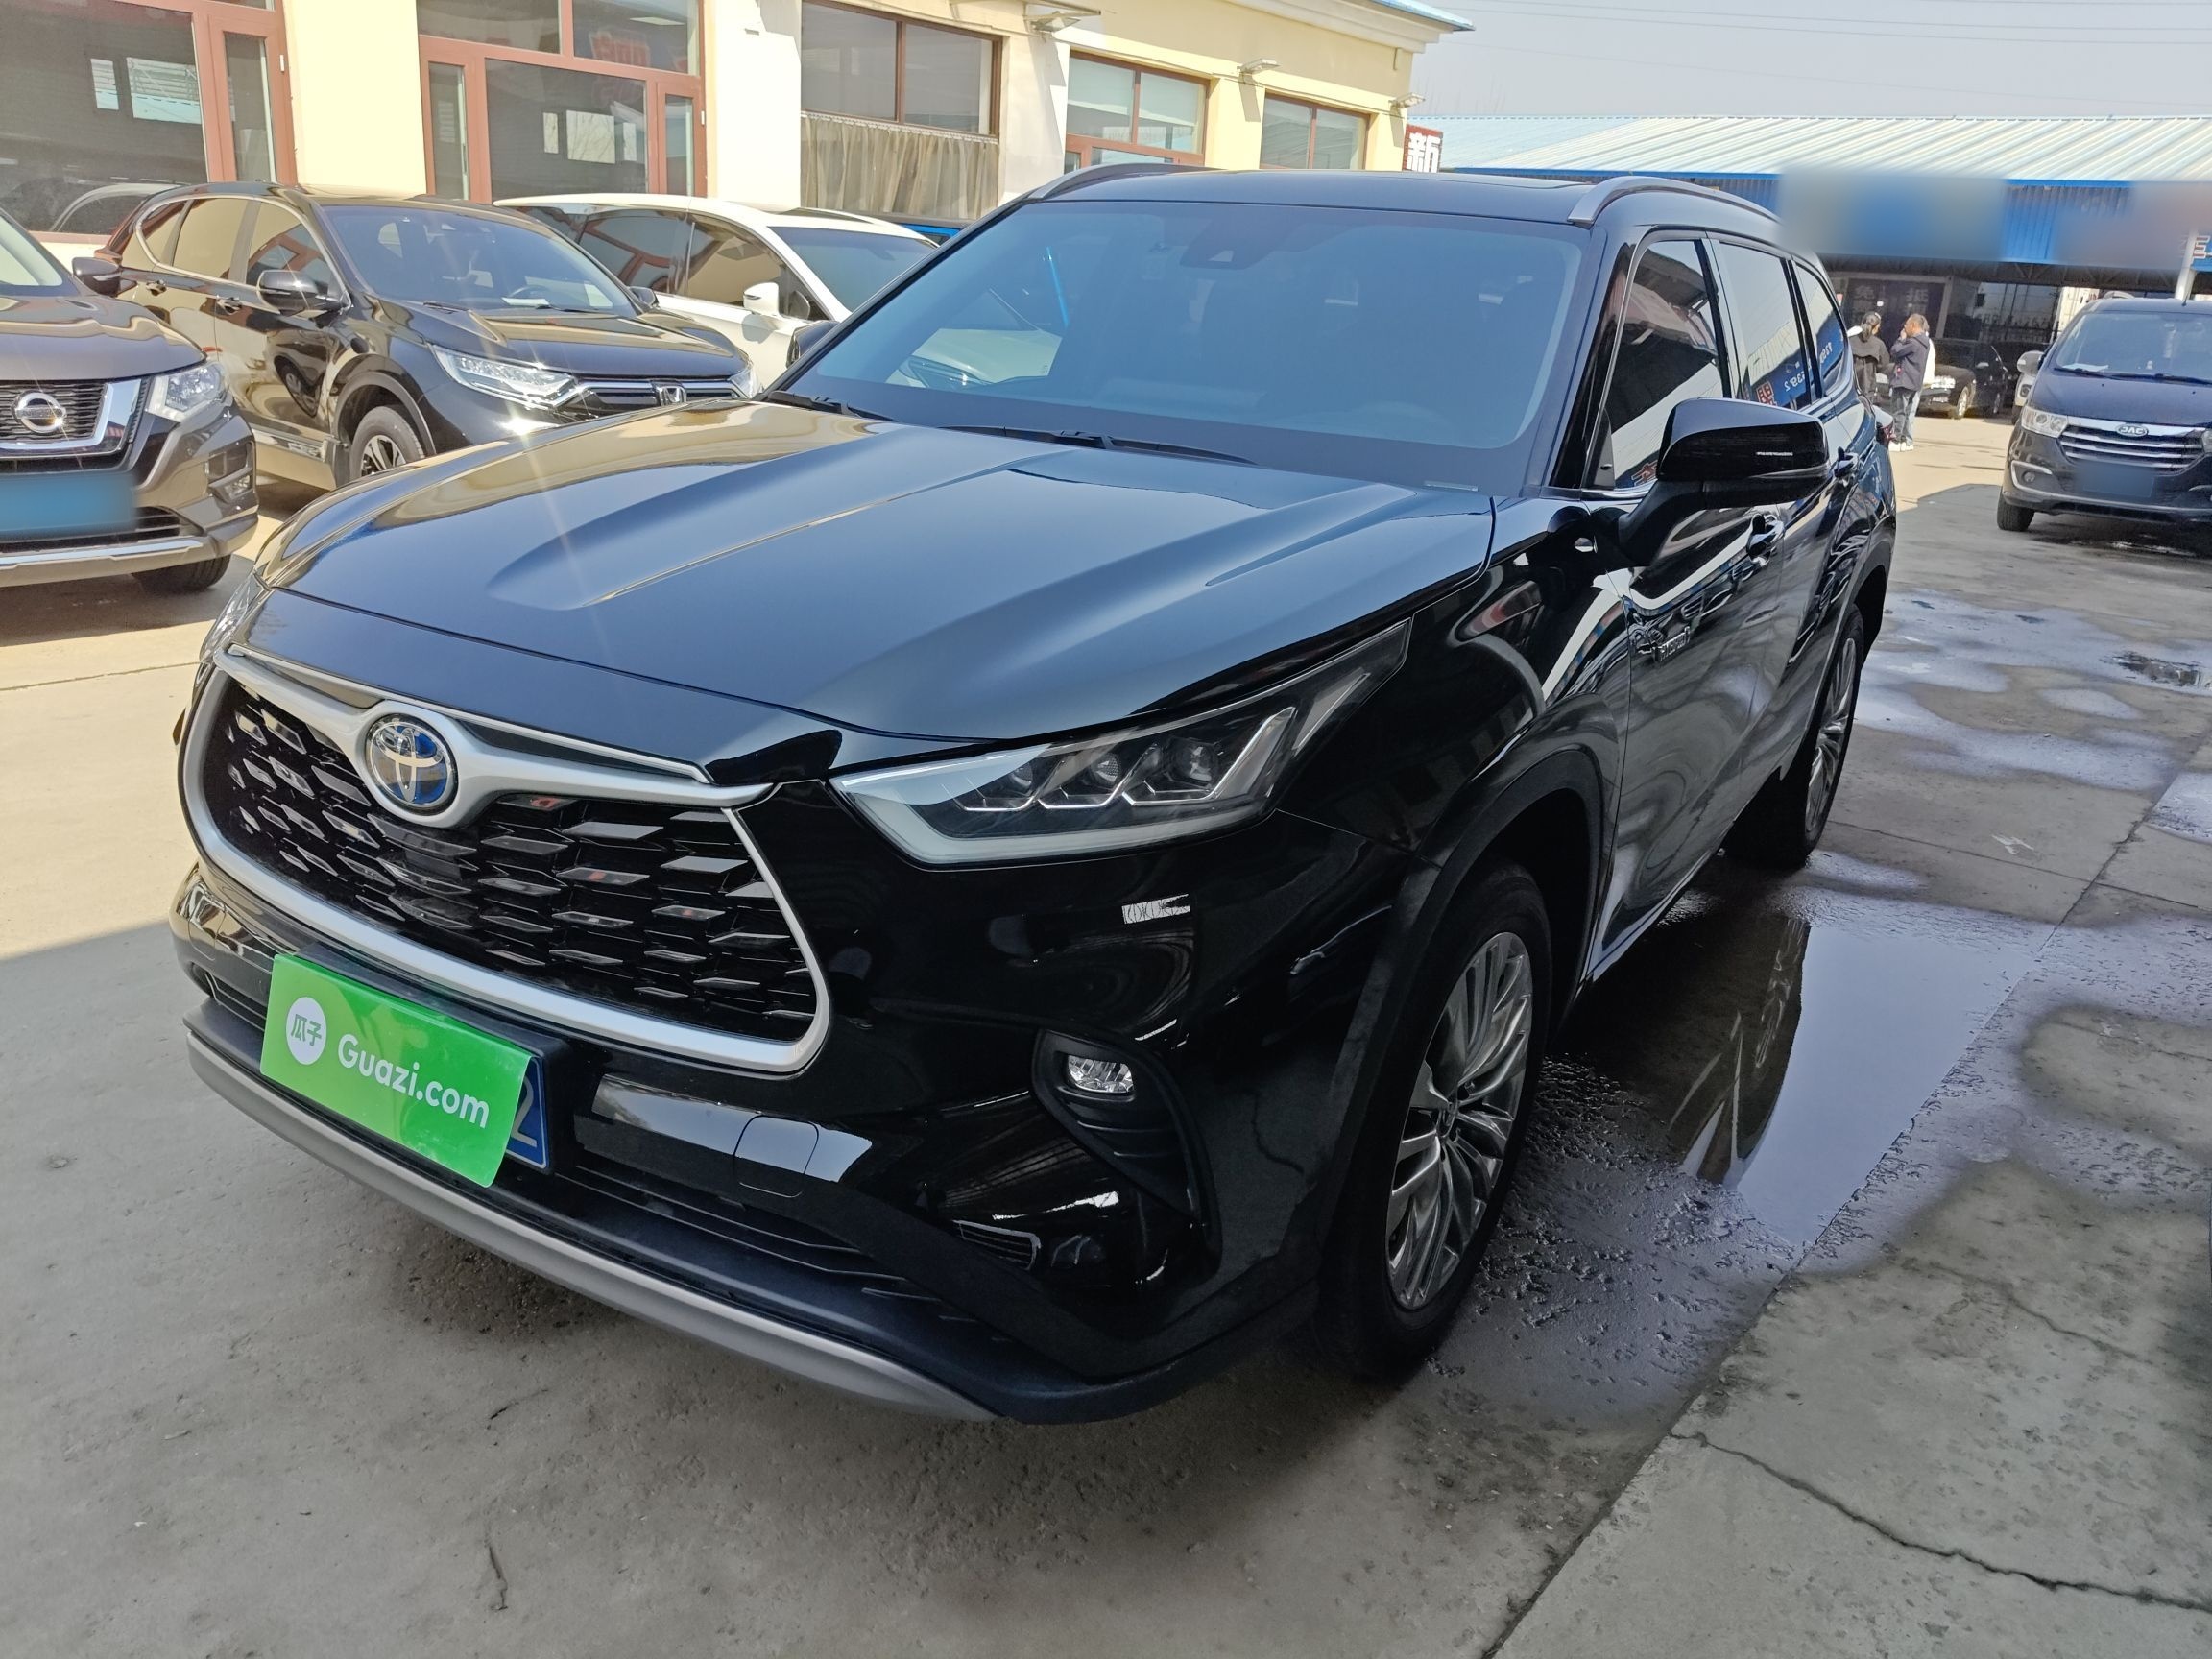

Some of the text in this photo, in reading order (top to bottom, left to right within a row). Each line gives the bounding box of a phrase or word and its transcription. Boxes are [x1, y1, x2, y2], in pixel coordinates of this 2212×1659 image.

[1407, 132, 1441, 173] 新
[291, 1014, 322, 1046] 瓜子
[338, 1034, 490, 1128] Guazi.com
